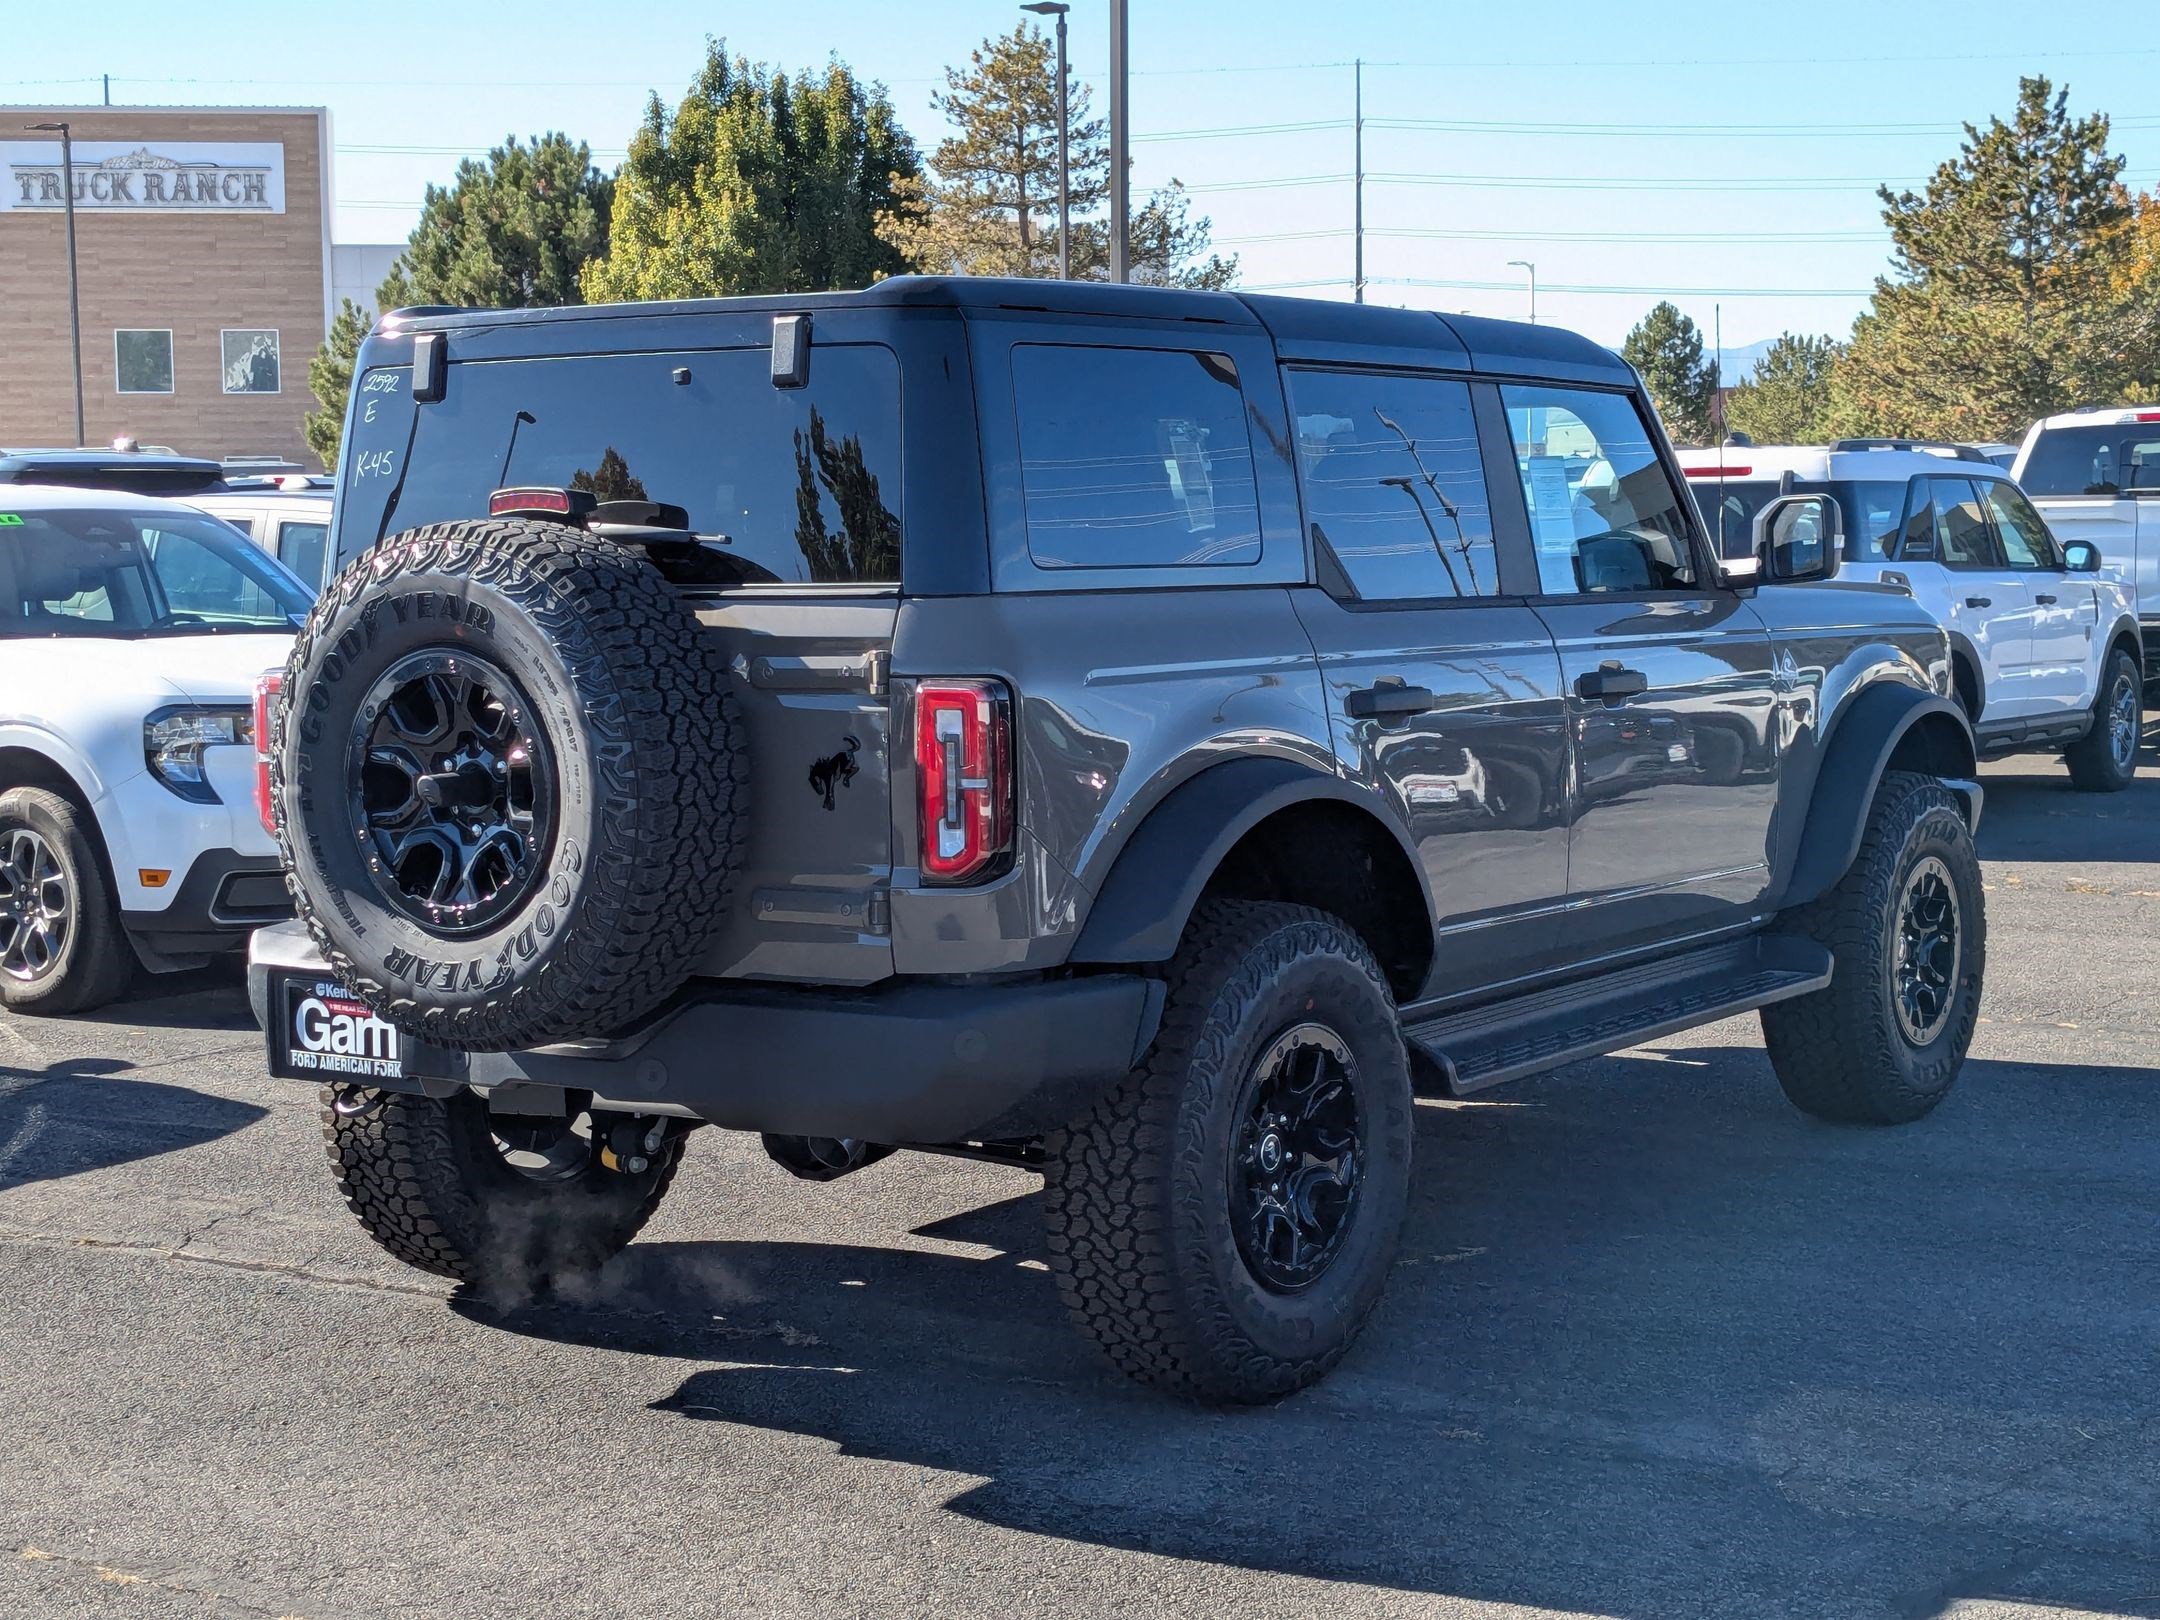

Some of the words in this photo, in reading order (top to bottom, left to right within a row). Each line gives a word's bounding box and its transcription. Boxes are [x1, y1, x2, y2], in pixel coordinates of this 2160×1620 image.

[15, 173, 136, 202] TRUCK
[143, 173, 267, 203] RANCH
[363, 374, 399, 393] 2592
[364, 399, 379, 423] E
[292, 1052, 318, 1069] FORD
[319, 1055, 372, 1076] AMERICAN
[373, 1061, 402, 1079] FORK
